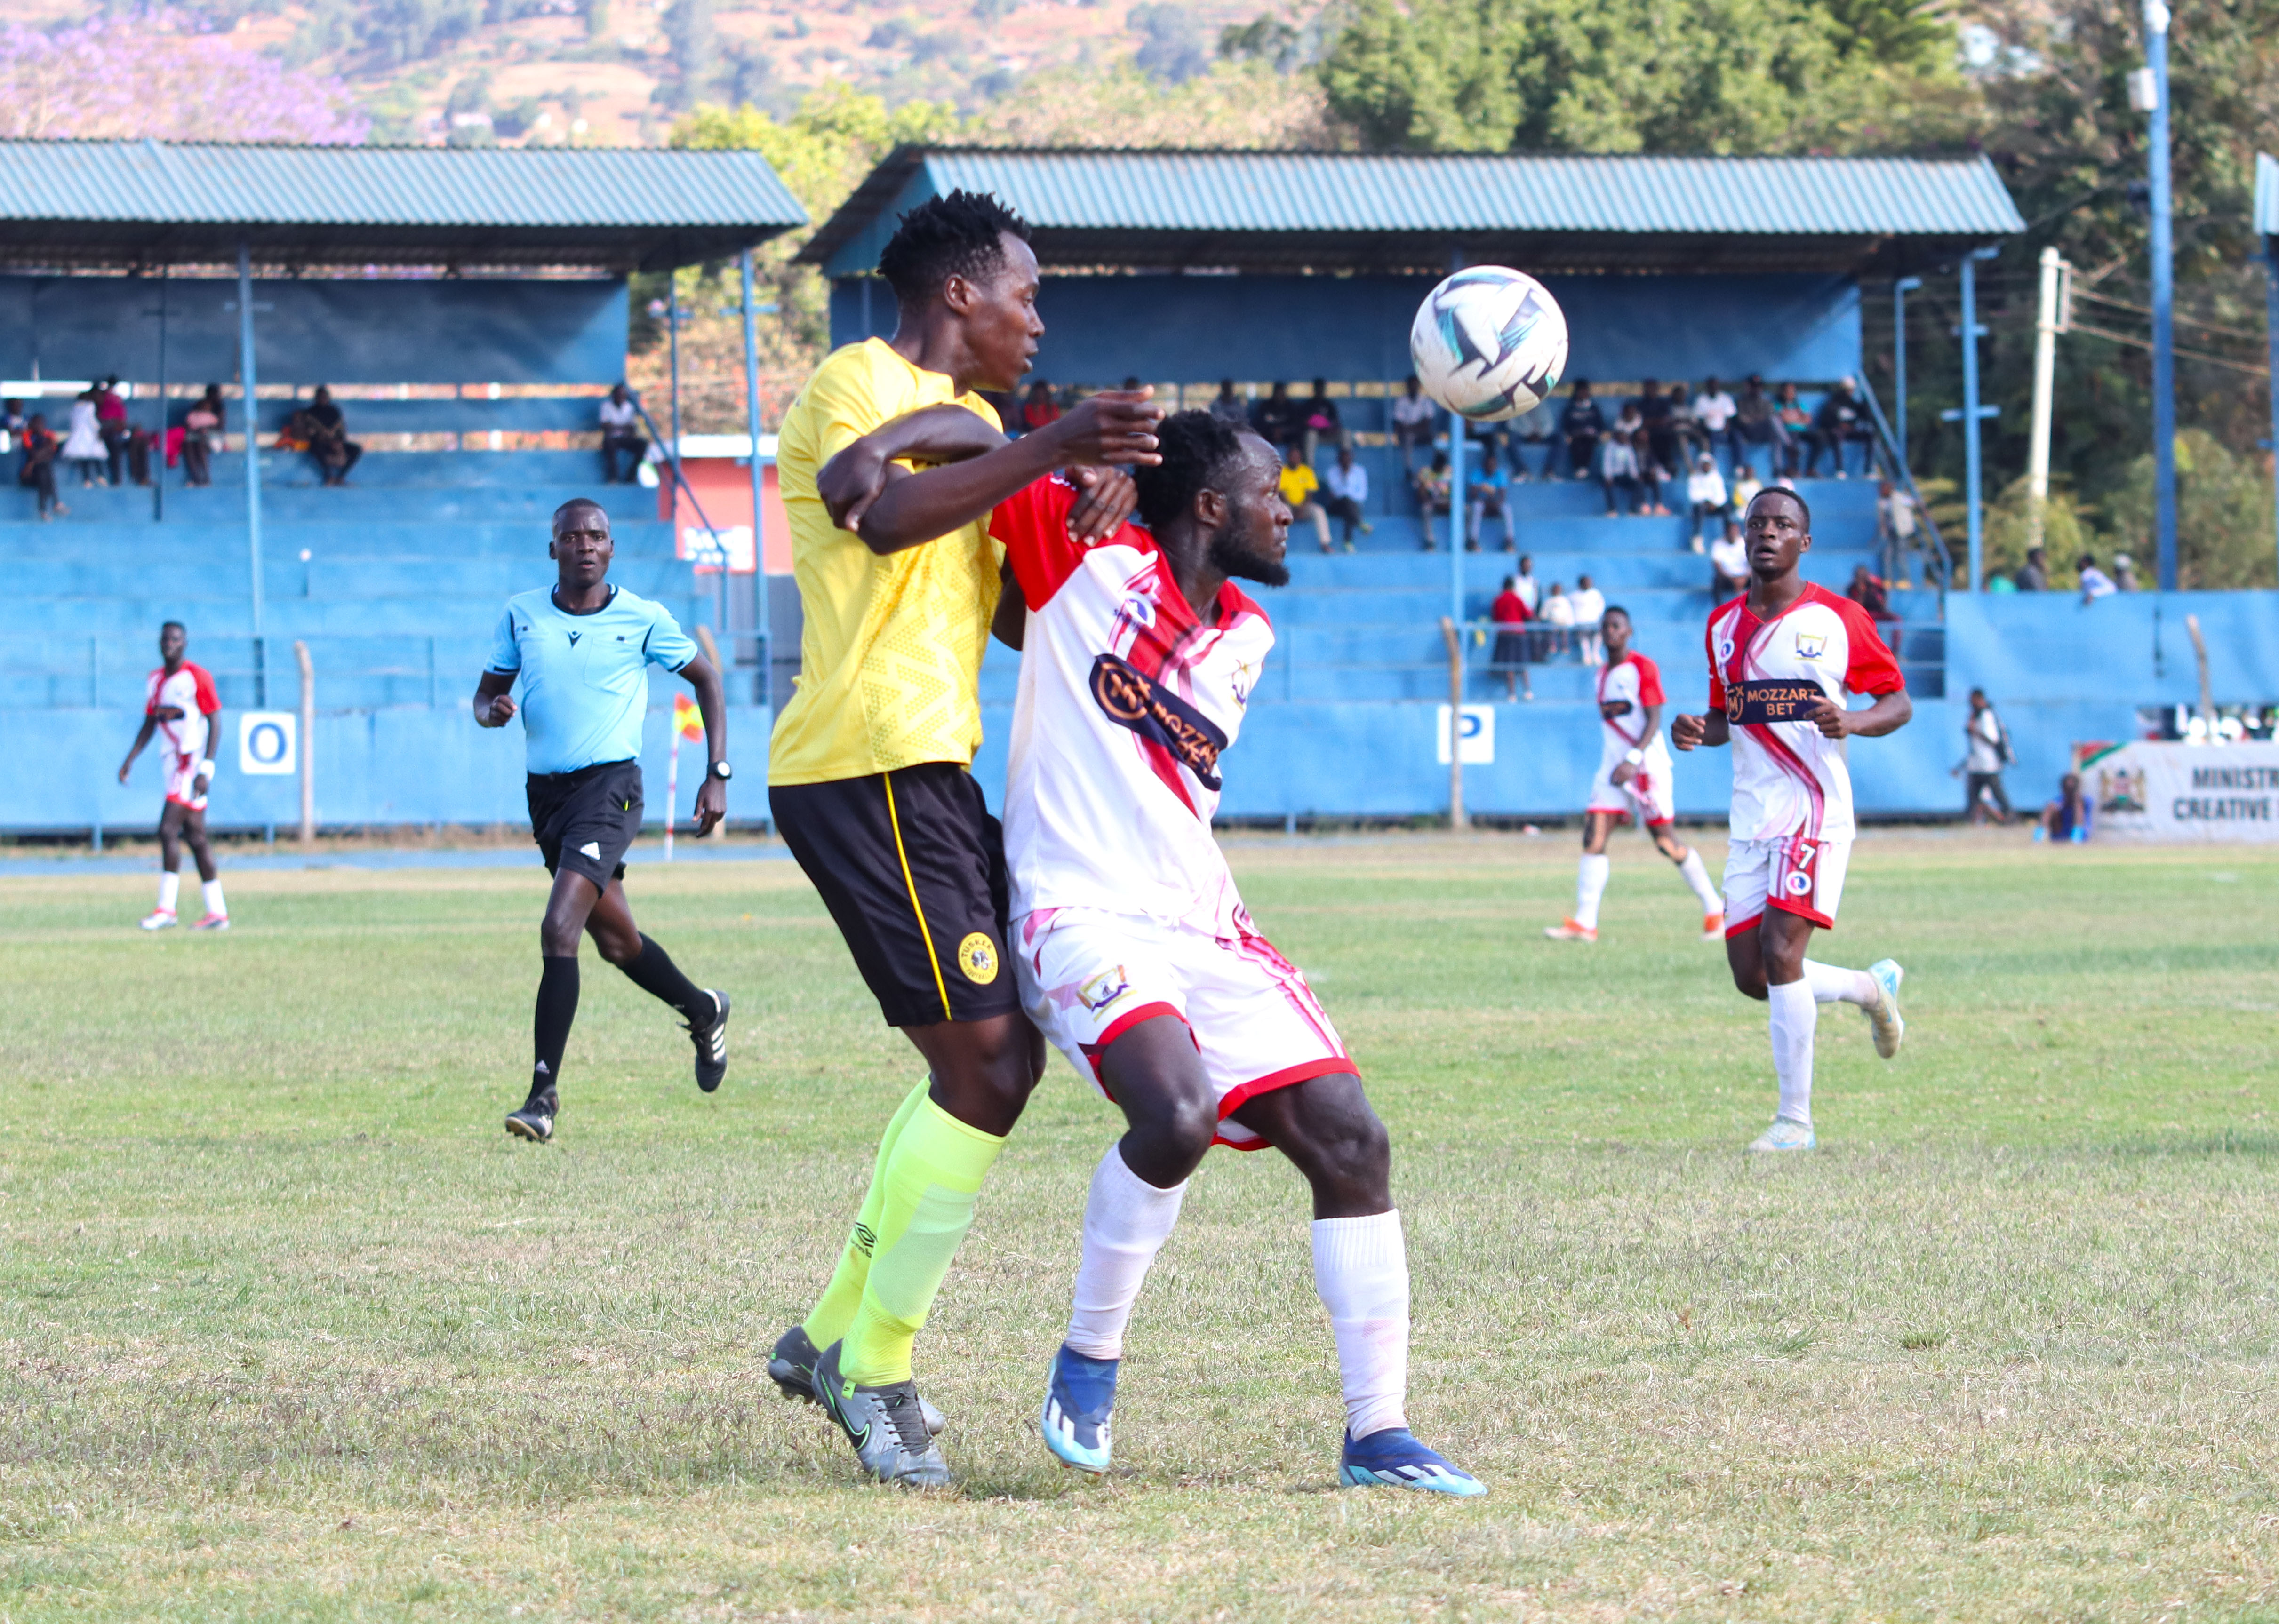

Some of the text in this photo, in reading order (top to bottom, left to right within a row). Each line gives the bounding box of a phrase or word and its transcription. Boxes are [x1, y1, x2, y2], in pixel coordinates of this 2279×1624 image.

[1747, 688, 1818, 703] MOZZART
[1767, 702, 1796, 716] BET
[248, 722, 288, 764] O
[2192, 767, 2279, 789] MINISTR
[2173, 797, 2271, 820] CREATIVE
[1799, 842, 1817, 869] 7
[961, 939, 992, 957] TUSKER
